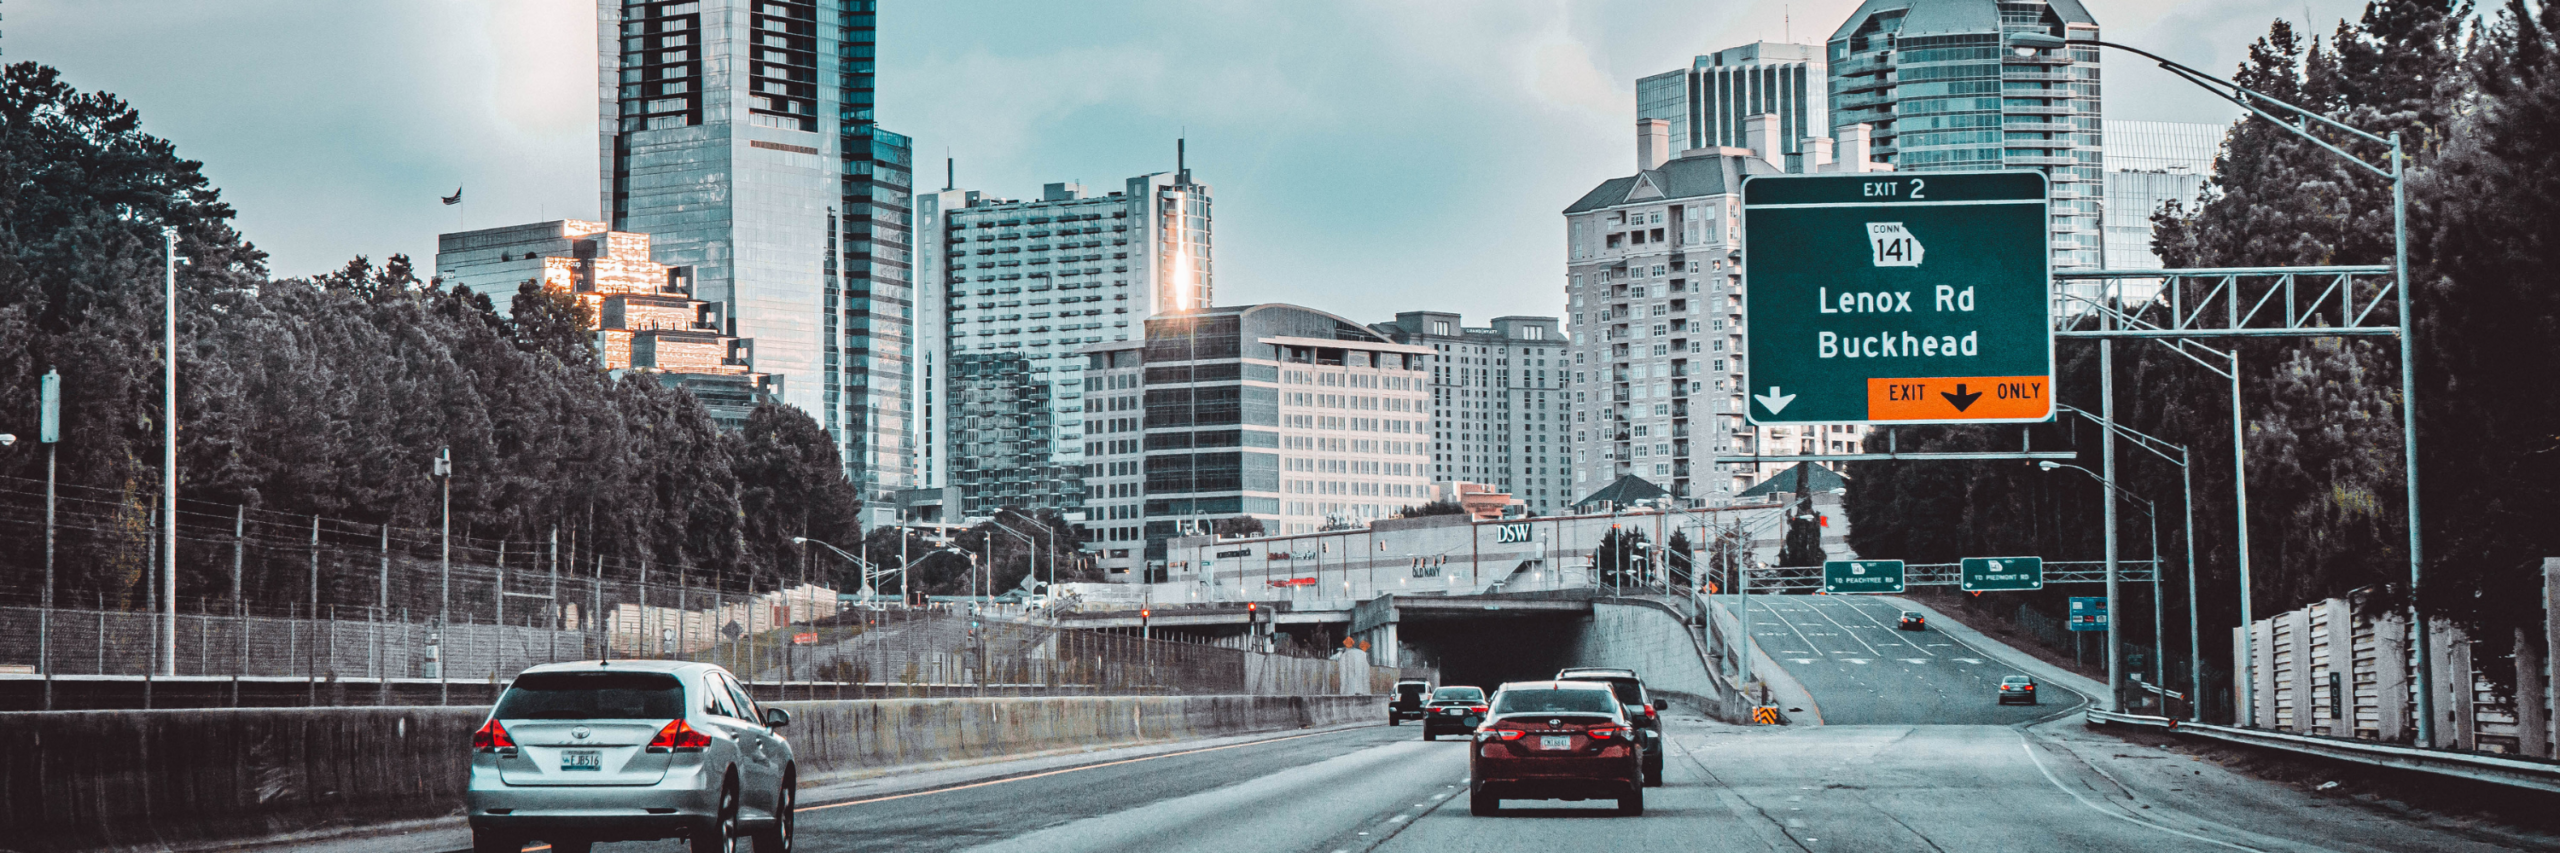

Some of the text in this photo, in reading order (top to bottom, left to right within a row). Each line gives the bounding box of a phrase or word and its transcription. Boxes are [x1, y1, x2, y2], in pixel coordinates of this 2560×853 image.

[1864, 179, 1925, 198] EXIT 2
[1873, 224, 1900, 234] CONN
[1877, 237, 1912, 262] 141
[1819, 285, 1975, 314] Lenox Rd
[1818, 330, 1978, 358] Buckhead
[1889, 383, 2041, 401] EXIT ONLY
[1497, 523, 1530, 543] DSW
[1412, 566, 1440, 577] OLD NAVY
